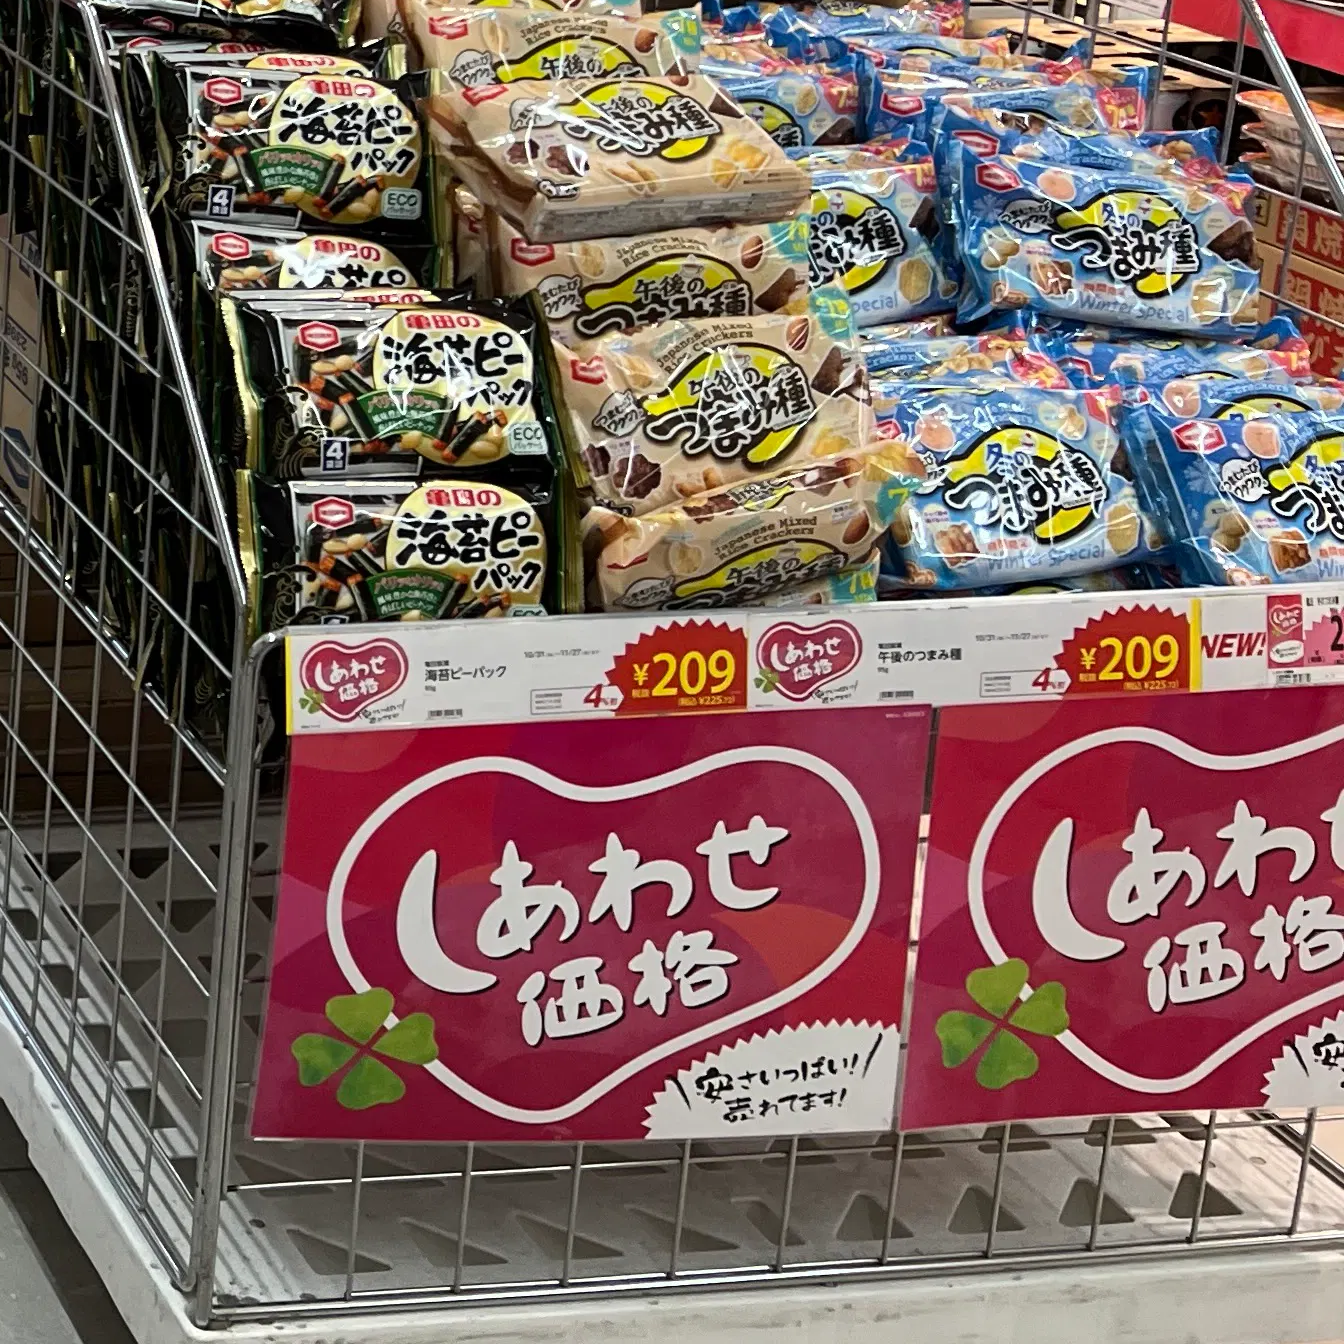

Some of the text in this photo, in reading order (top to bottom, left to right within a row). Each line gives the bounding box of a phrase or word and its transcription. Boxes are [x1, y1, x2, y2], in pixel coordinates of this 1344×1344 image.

[540, 55, 604, 79] 午後の
[307, 79, 375, 98] 亀田の
[350, 147, 417, 176] パック
[385, 189, 419, 209] ECO
[634, 279, 705, 298] 午後の
[405, 313, 481, 331] 亀田の
[382, 332, 526, 386] 海苔ピー
[465, 381, 534, 408] パック
[424, 488, 502, 508] 亀田の
[396, 511, 540, 567] 海苔ピー
[472, 560, 542, 593] パック
[725, 556, 800, 586] 午後の
[769, 635, 841, 675] しあわせ
[878, 648, 963, 665] 午後のつまみ種
[1098, 634, 1180, 682] 209
[1200, 631, 1266, 659] NEW!
[315, 655, 386, 694] しあわせ
[424, 665, 508, 682] 海苔ピーパック
[651, 649, 736, 697] 209
[791, 657, 833, 684] 価格
[336, 676, 380, 703] 価格
[394, 813, 792, 996] しあわせ
[1141, 894, 1344, 1015] 価格
[514, 927, 741, 1049] 価格
[692, 1049, 864, 1105] 安さいっぱい!
[721, 1086, 849, 1126] 売れてます!
